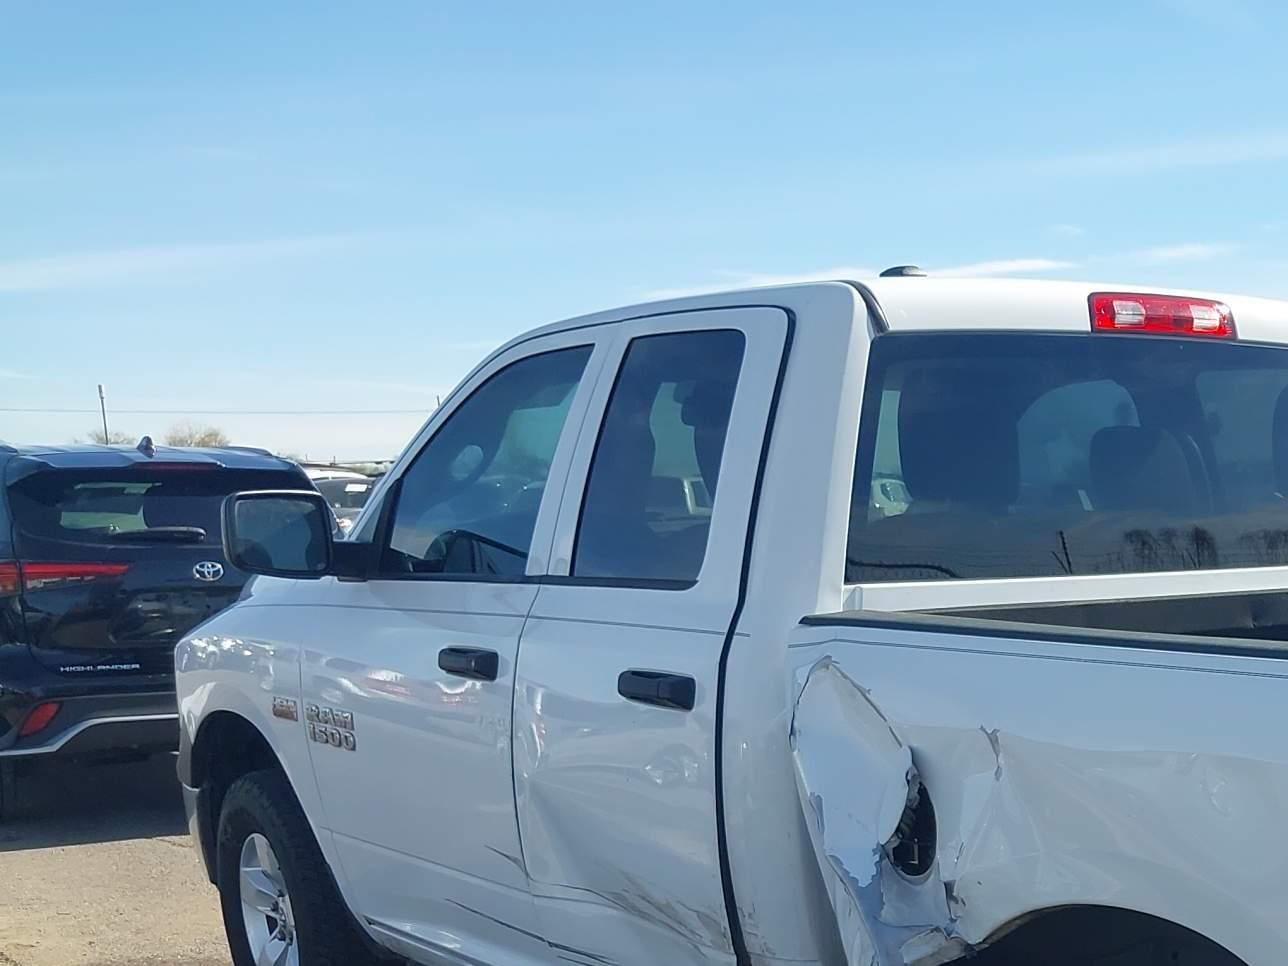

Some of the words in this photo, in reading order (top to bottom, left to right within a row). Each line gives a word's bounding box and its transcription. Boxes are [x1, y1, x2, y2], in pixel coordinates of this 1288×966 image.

[60, 663, 141, 673] HIGHLANDER
[305, 703, 355, 731] RAM
[308, 722, 357, 751] 1500
